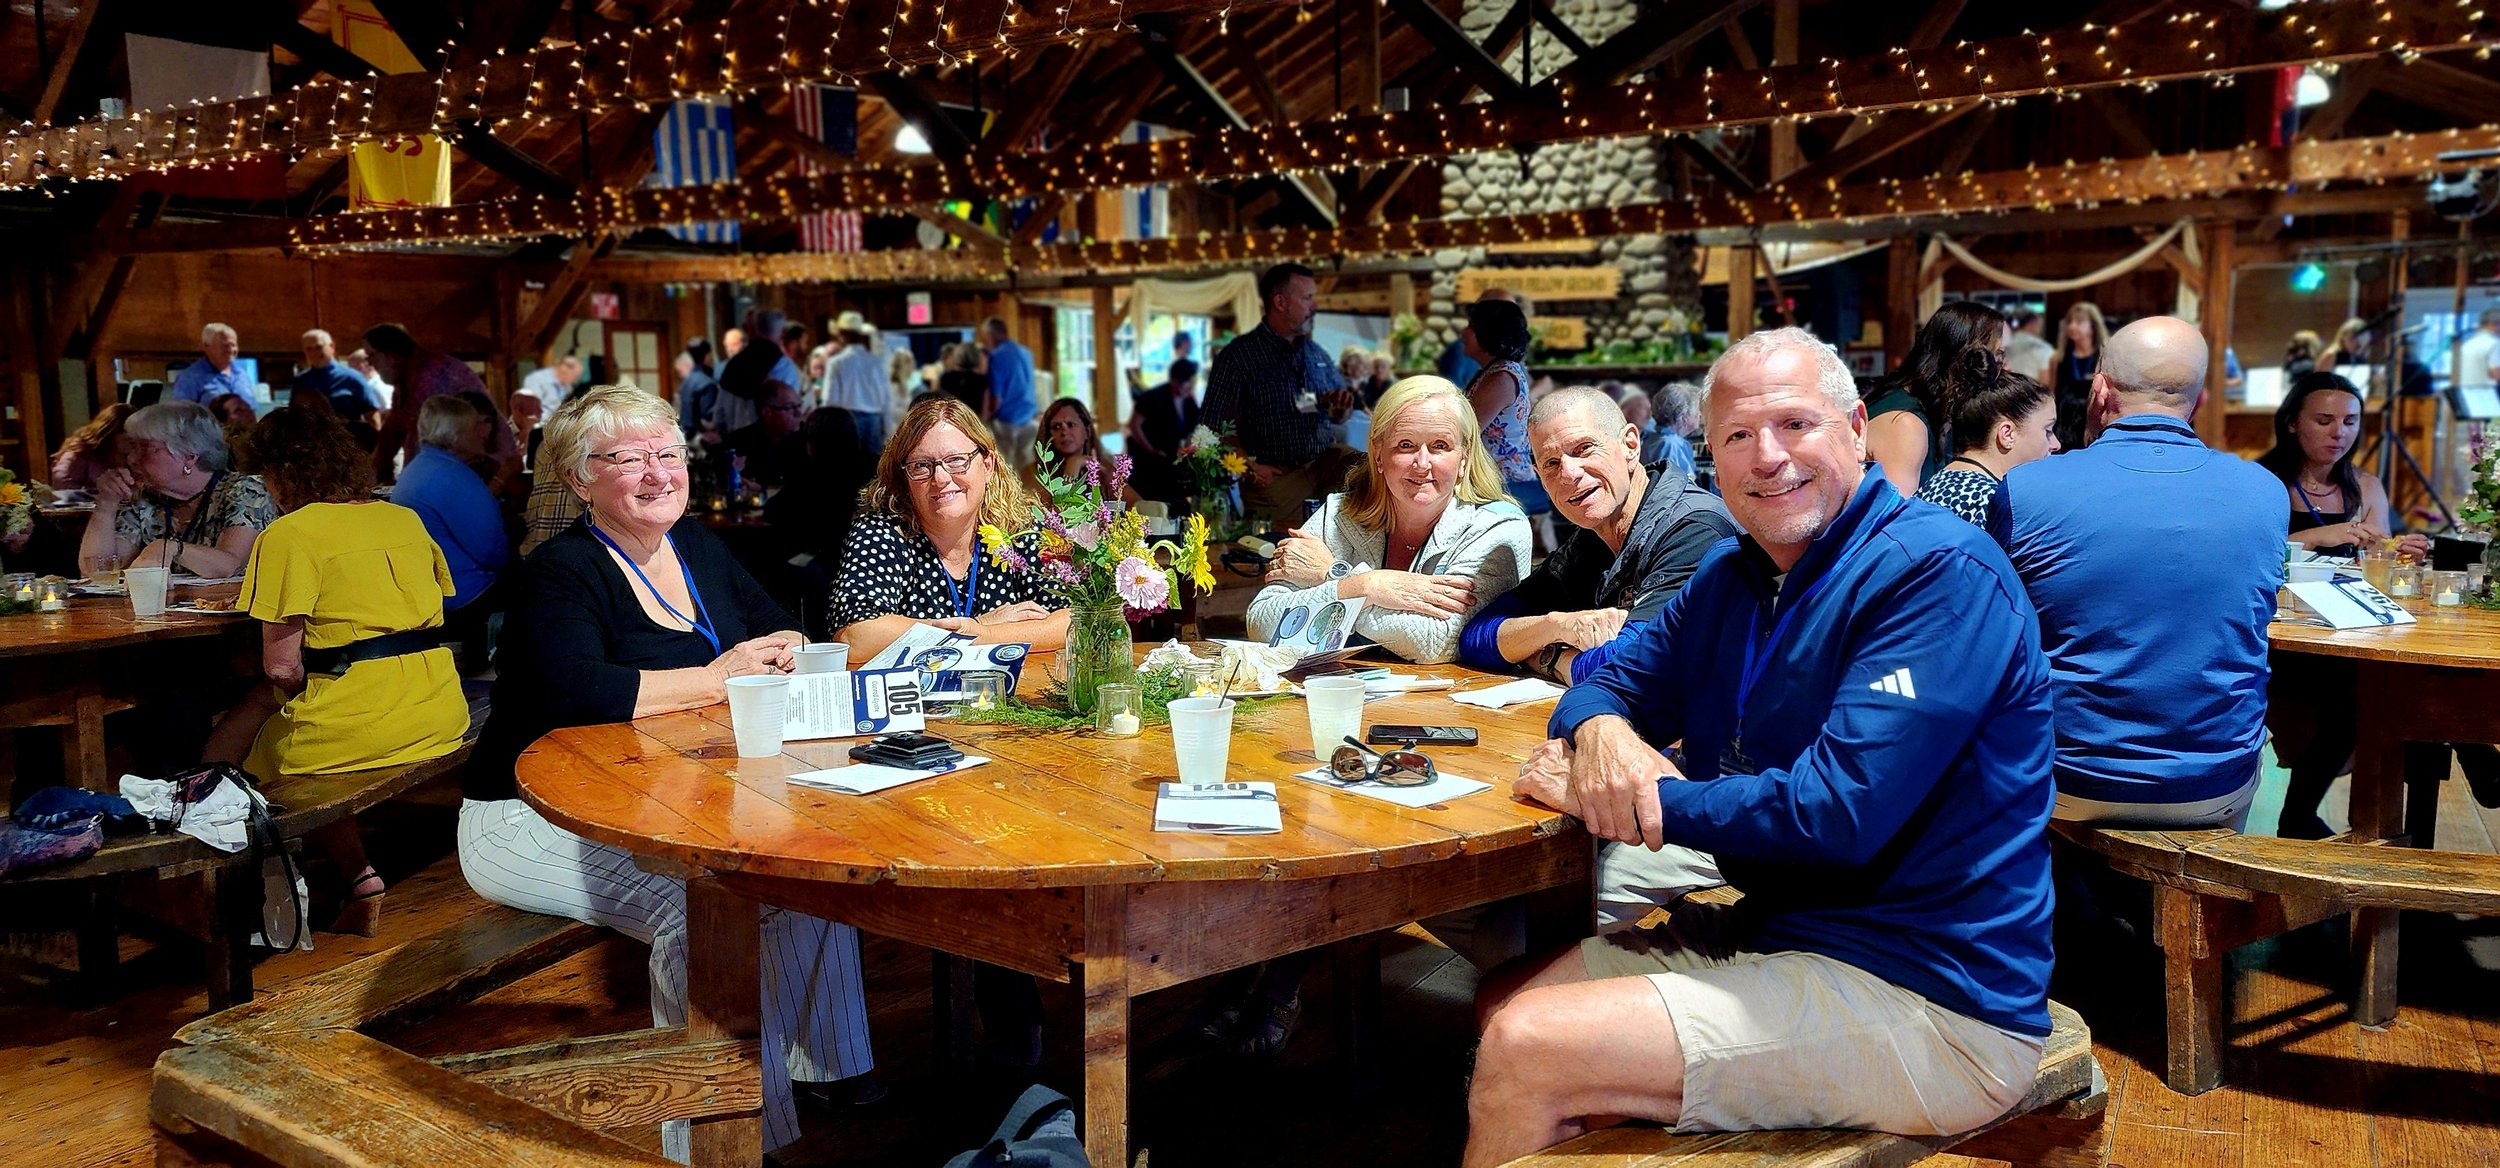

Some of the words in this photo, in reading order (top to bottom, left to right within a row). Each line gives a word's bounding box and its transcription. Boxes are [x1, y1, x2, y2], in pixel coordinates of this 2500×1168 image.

[2360, 587, 2402, 612] 262
[888, 681, 921, 715] 105
[1193, 783, 1248, 791] 140
